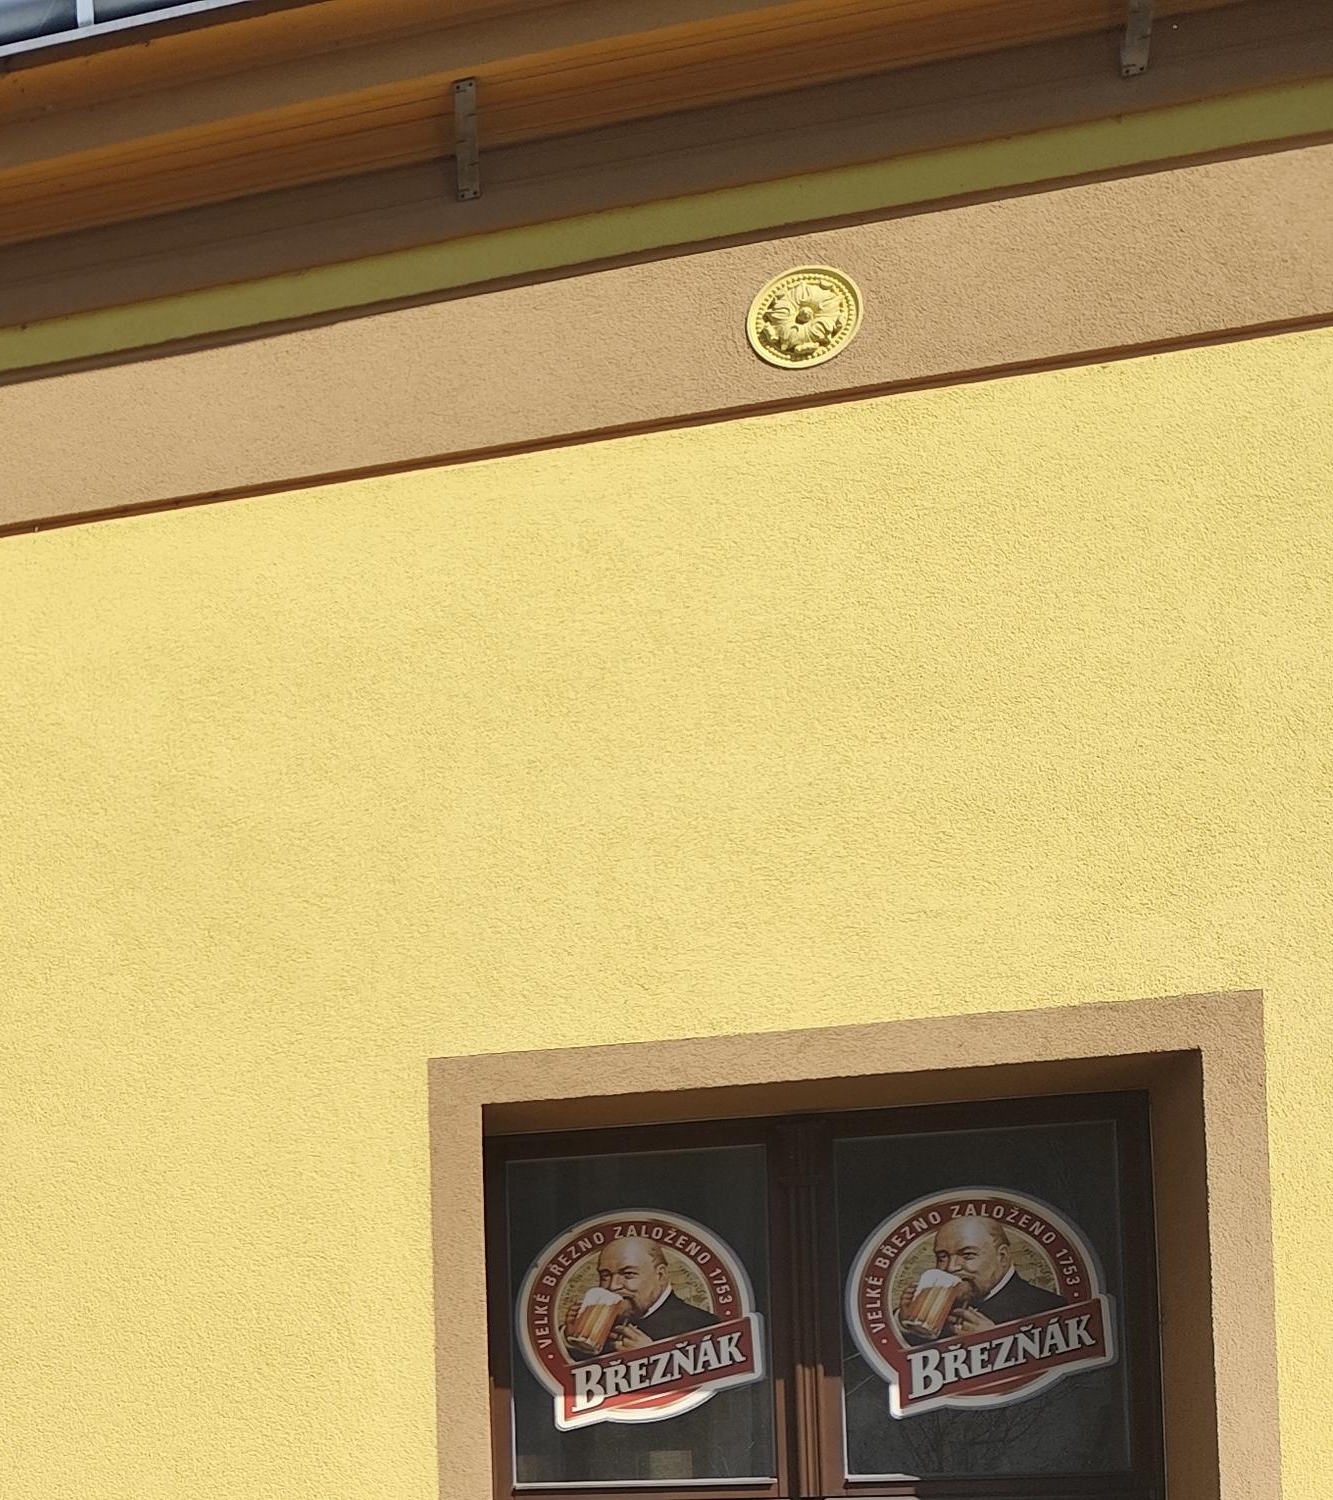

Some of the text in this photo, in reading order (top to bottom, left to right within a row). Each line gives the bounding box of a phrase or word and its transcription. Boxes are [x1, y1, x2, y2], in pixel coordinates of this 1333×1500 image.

[534, 1225, 733, 1349] VELKÉ BŘEZNO ZALOŽENO 1753
[865, 1274, 883, 1333] VELKÉ
[876, 1211, 942, 1269] BŘEZNO
[950, 1203, 1056, 1245] ZALOŽENO
[1054, 1248, 1081, 1286] 1753
[571, 1332, 746, 1413] BŘEZŇÁK
[907, 1313, 1096, 1400] BŘEZŇÁK
